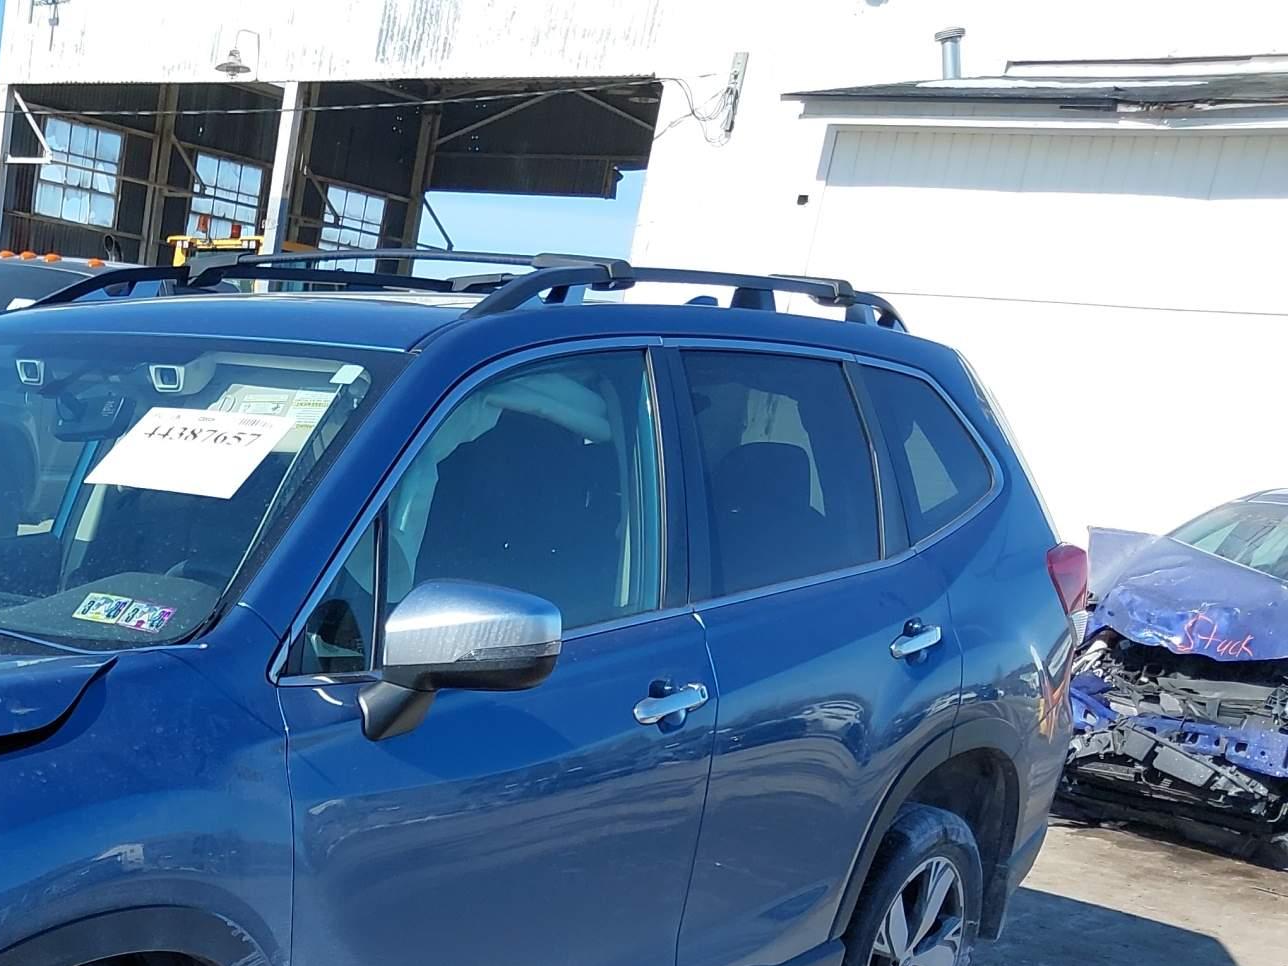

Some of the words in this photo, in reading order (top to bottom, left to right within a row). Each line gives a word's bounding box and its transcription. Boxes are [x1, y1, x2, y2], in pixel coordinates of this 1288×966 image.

[143, 425, 262, 447] 44387657
[81, 600, 95, 615] 3
[124, 607, 139, 622] 3
